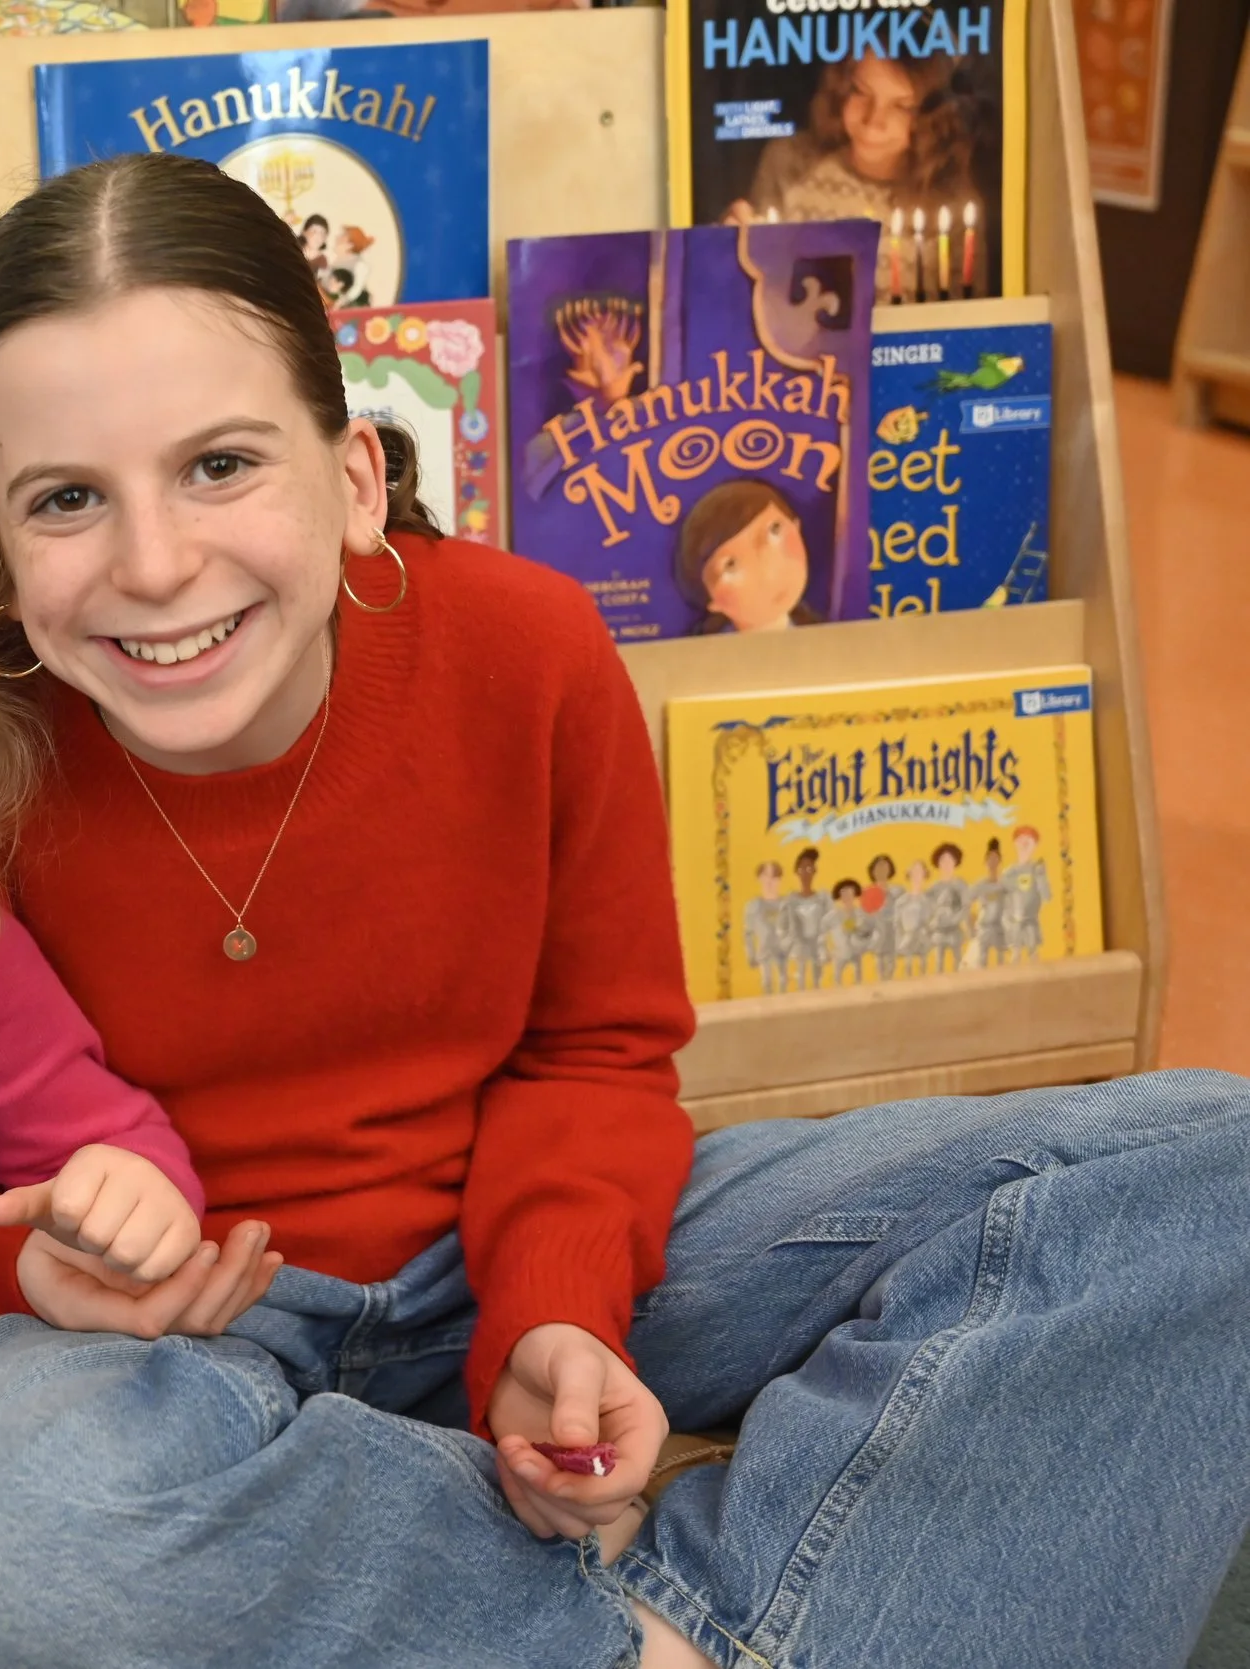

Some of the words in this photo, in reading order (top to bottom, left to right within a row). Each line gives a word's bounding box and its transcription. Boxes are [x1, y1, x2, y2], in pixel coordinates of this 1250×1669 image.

[703, 6, 990, 69] HANUKKAH
[129, 66, 437, 153] Hanukkah!
[872, 343, 943, 366] SINGER
[543, 349, 850, 470] Hanukkah
[995, 404, 1042, 422] Library
[765, 748, 871, 834] Eight
[877, 727, 1020, 801] Knights
[851, 801, 951, 829] HANUKKAH
